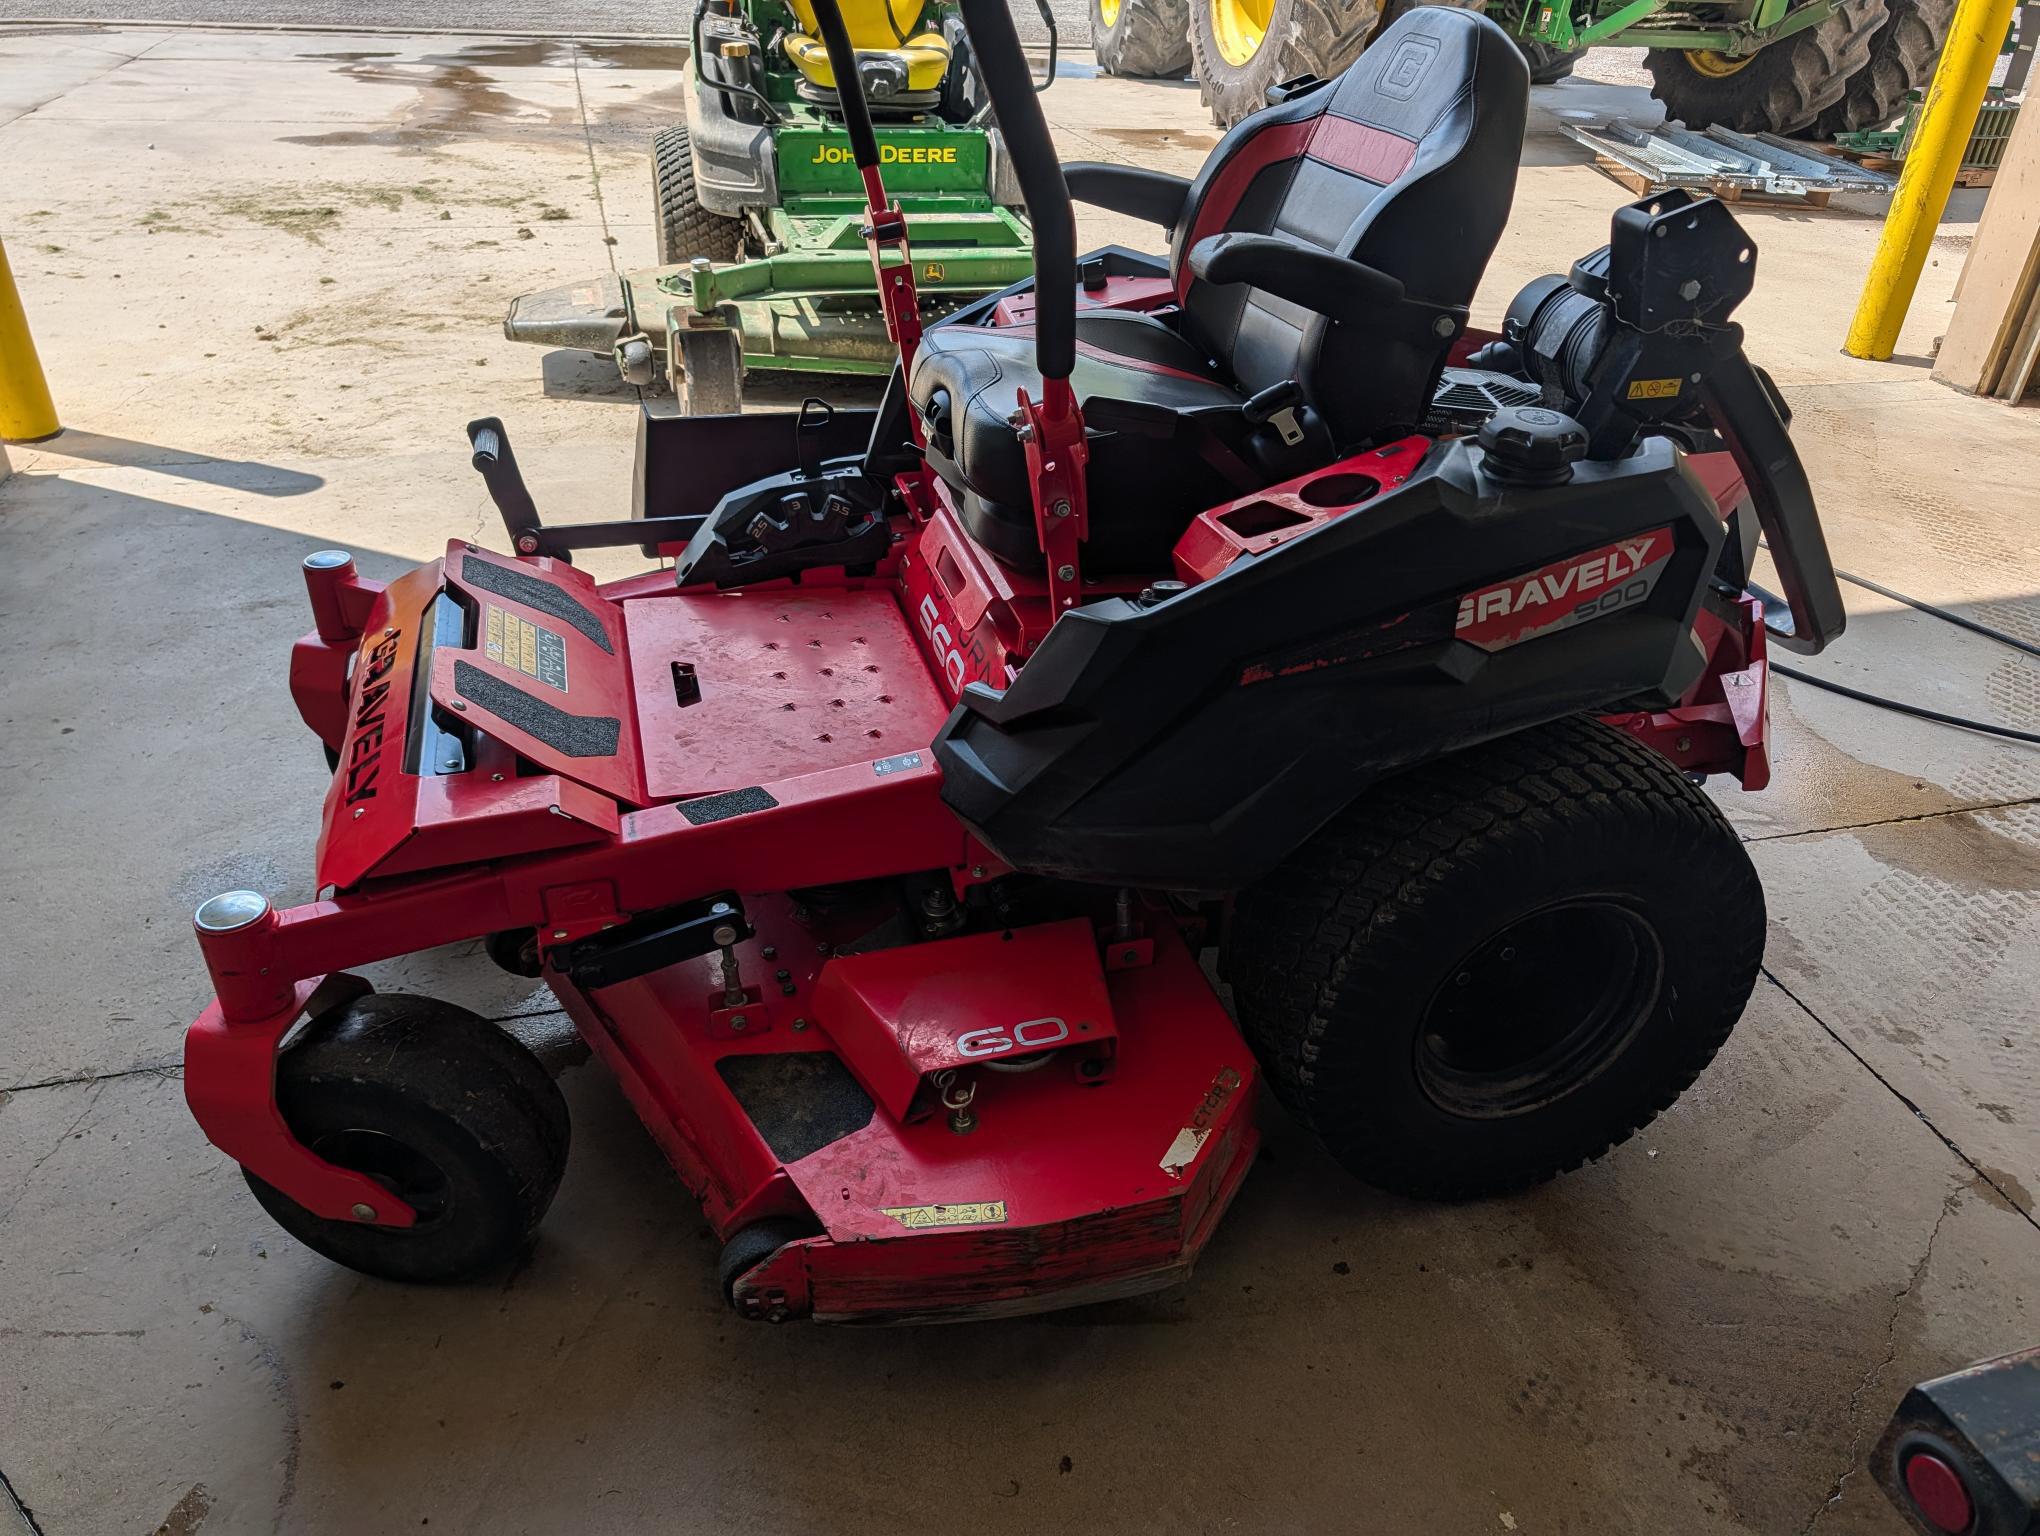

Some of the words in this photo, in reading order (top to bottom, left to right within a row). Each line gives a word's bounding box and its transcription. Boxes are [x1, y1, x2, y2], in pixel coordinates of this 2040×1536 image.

[812, 144, 856, 164] JOH
[880, 144, 957, 164] DEERE
[751, 521, 768, 539] 2.5
[1456, 538, 1656, 630] GRAVELY
[1574, 580, 1648, 620] 500
[920, 593, 965, 695] 560
[346, 629, 402, 808] GRAVELY
[957, 1017, 1069, 1057] 60
